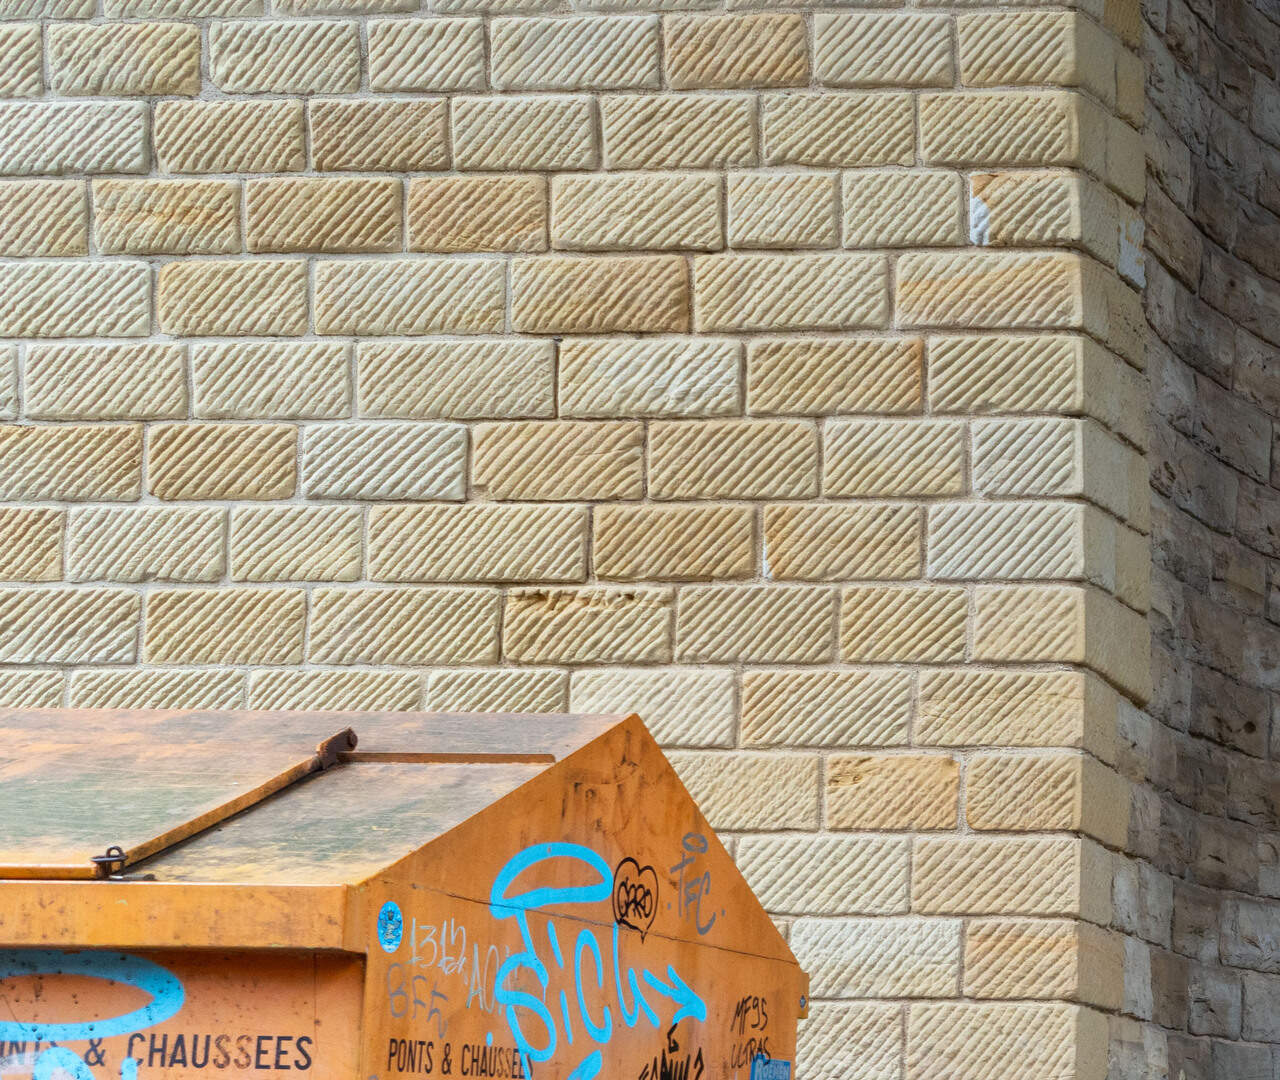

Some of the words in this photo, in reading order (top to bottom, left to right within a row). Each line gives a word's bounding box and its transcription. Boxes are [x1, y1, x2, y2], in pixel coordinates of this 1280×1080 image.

[127, 1033, 313, 1071] CHAUSSEES
[387, 1038, 434, 1075] PONTS
[441, 1043, 453, 1075] &
